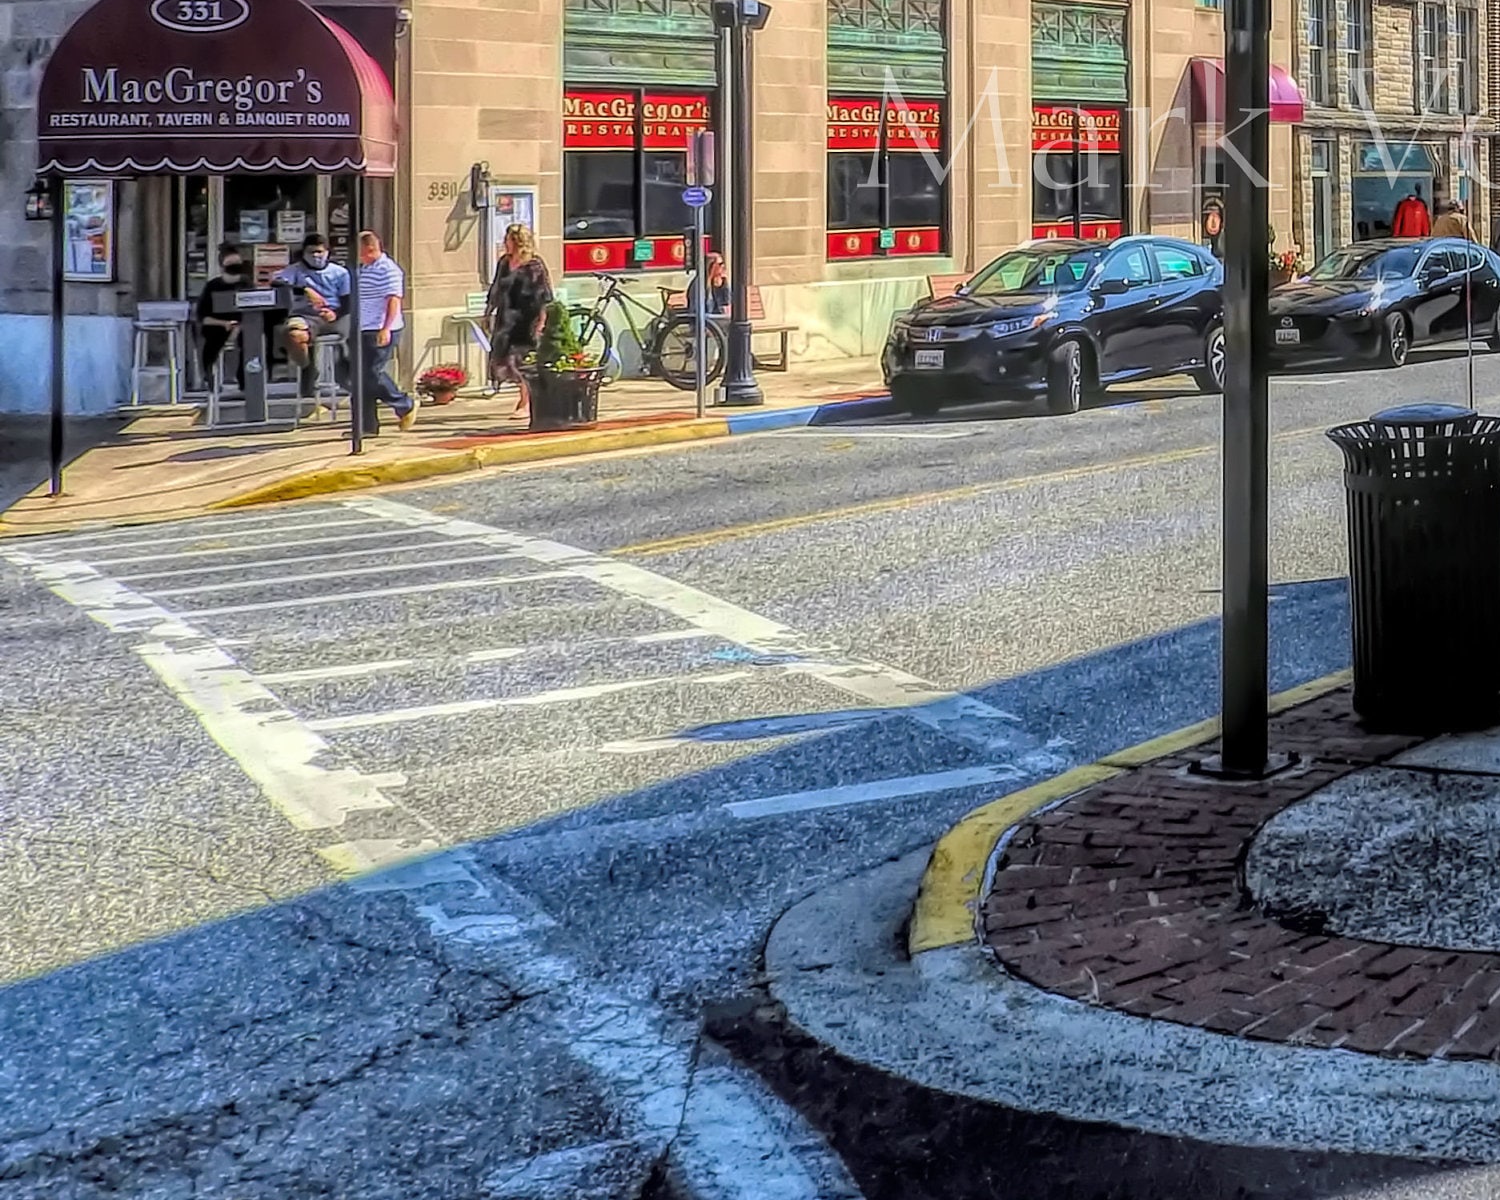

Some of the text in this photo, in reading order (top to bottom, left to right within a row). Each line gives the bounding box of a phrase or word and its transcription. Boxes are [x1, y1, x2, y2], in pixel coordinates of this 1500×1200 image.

[177, 0, 225, 21] 331
[81, 66, 323, 111] MacGregor's
[156, 112, 213, 127] TAVERN
[218, 112, 230, 127] &
[234, 112, 303, 127] BANQUET
[307, 112, 351, 127] ROOM
[564, 98, 711, 122] MacGregor's
